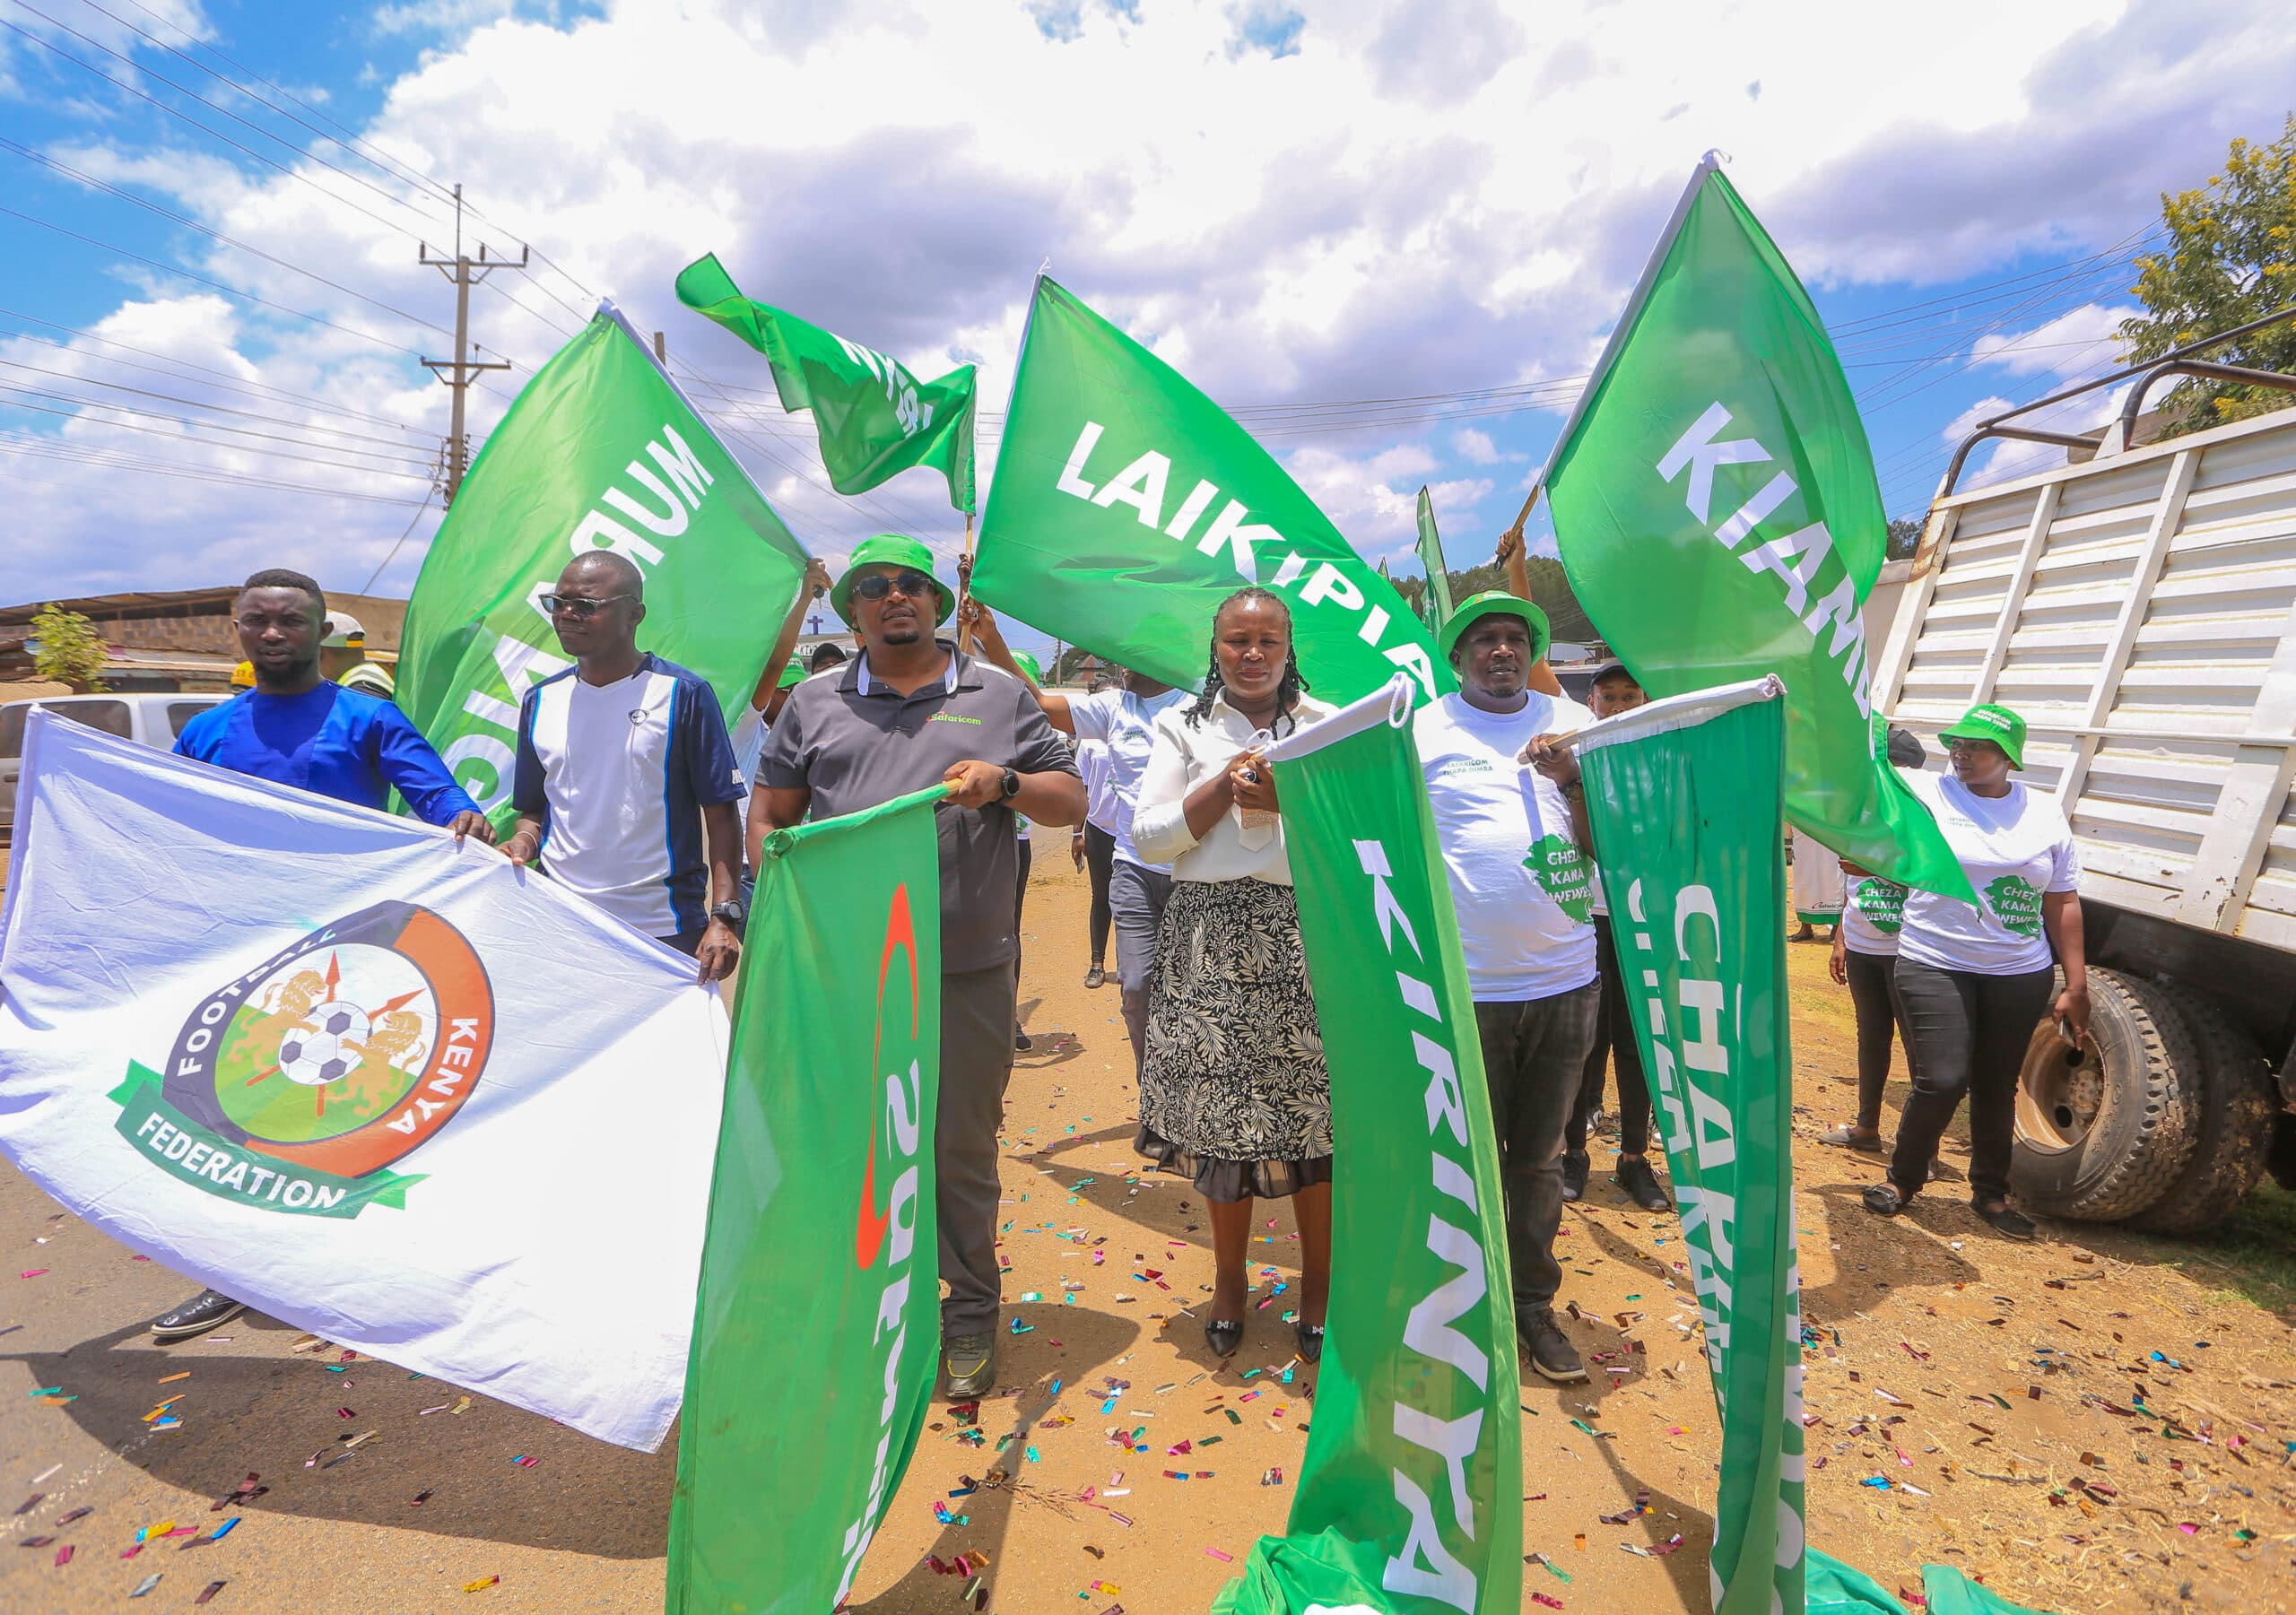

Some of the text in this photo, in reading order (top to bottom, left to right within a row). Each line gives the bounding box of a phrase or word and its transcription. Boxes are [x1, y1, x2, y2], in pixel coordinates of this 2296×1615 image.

[1056, 421, 1437, 700] LAIKIPIA
[1656, 400, 1874, 760] KIAM
[930, 714, 982, 725] Safaricom
[1551, 868, 1585, 885] KAMA
[1866, 888, 1901, 899] CHEZA
[2003, 886, 2036, 901] CHEZ
[1865, 900, 1900, 910] KAMA
[386, 1018, 479, 1136] KENYA
[137, 1112, 347, 1210] FEDERATION
